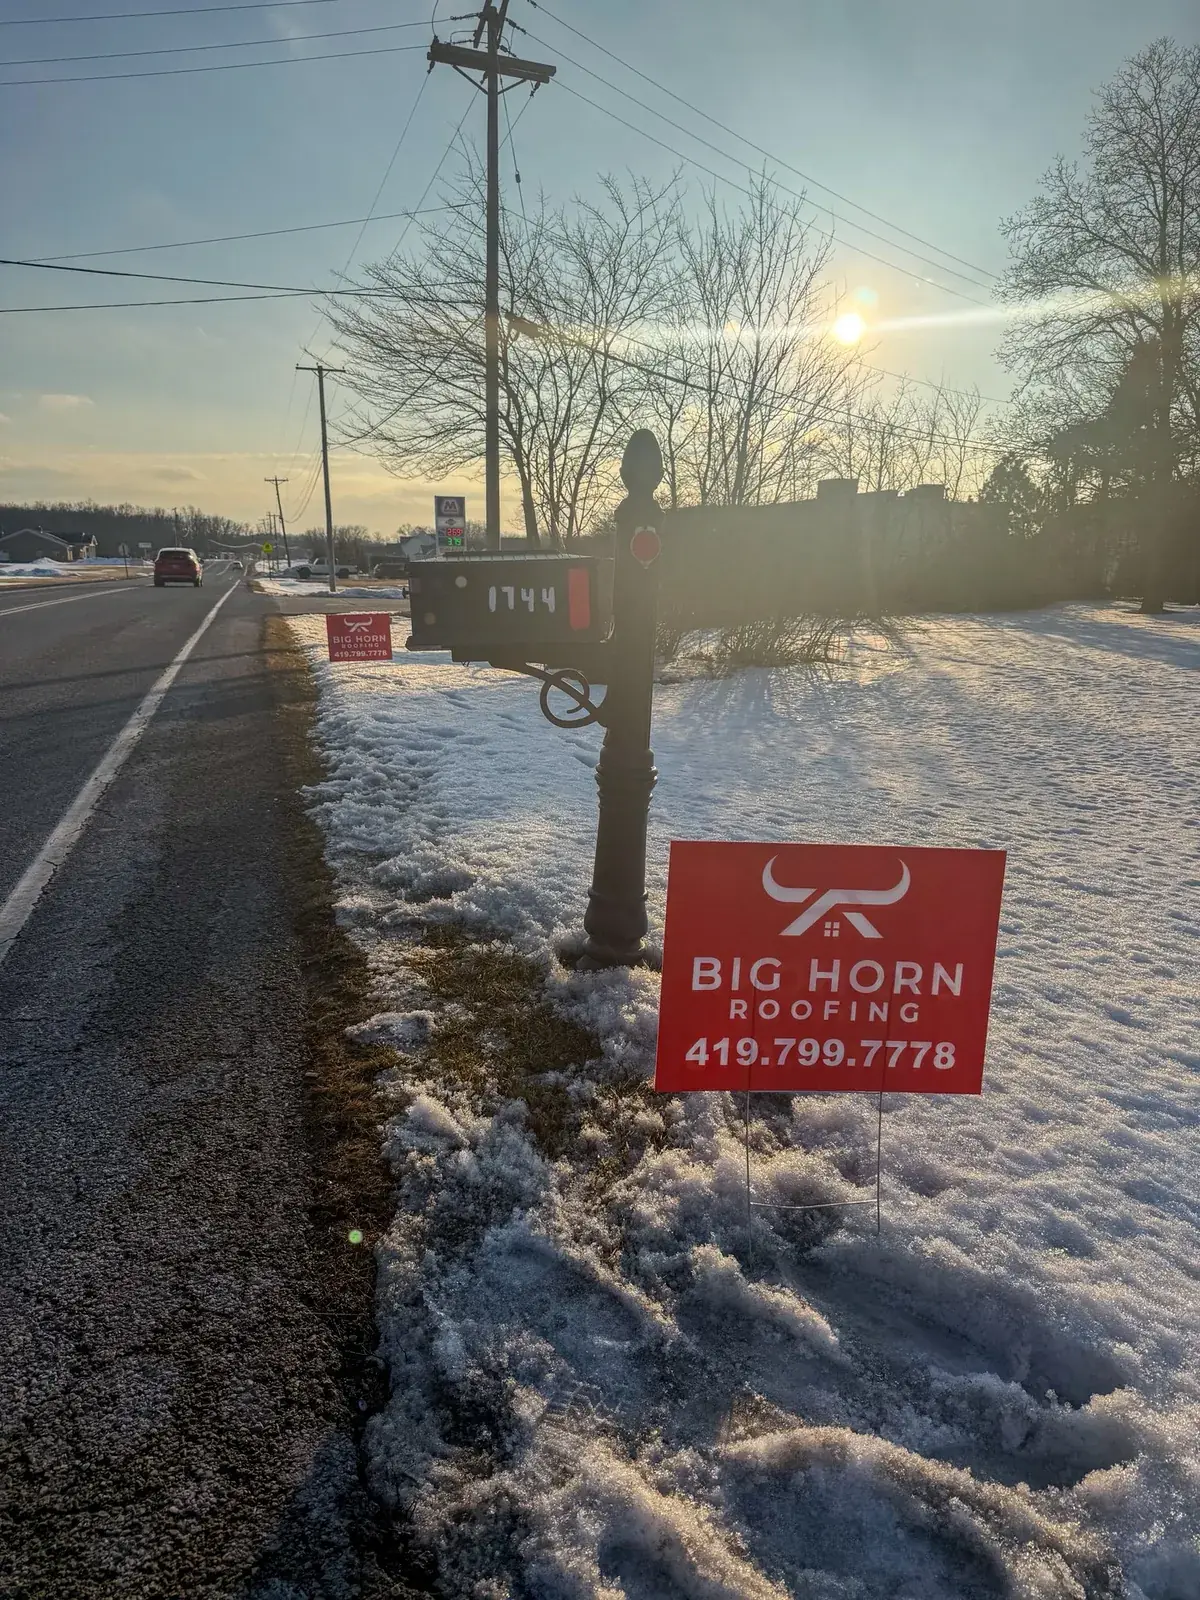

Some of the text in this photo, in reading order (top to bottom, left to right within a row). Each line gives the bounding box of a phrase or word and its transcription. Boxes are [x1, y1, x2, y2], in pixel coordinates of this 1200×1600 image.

[488, 586, 556, 613] 1744
[332, 634, 386, 644] BIG HORN
[334, 649, 388, 658] 419.799.7778
[691, 956, 964, 997] BIG HORN
[729, 998, 920, 1023] ROOFING
[685, 1037, 956, 1070] 419.799.7778
